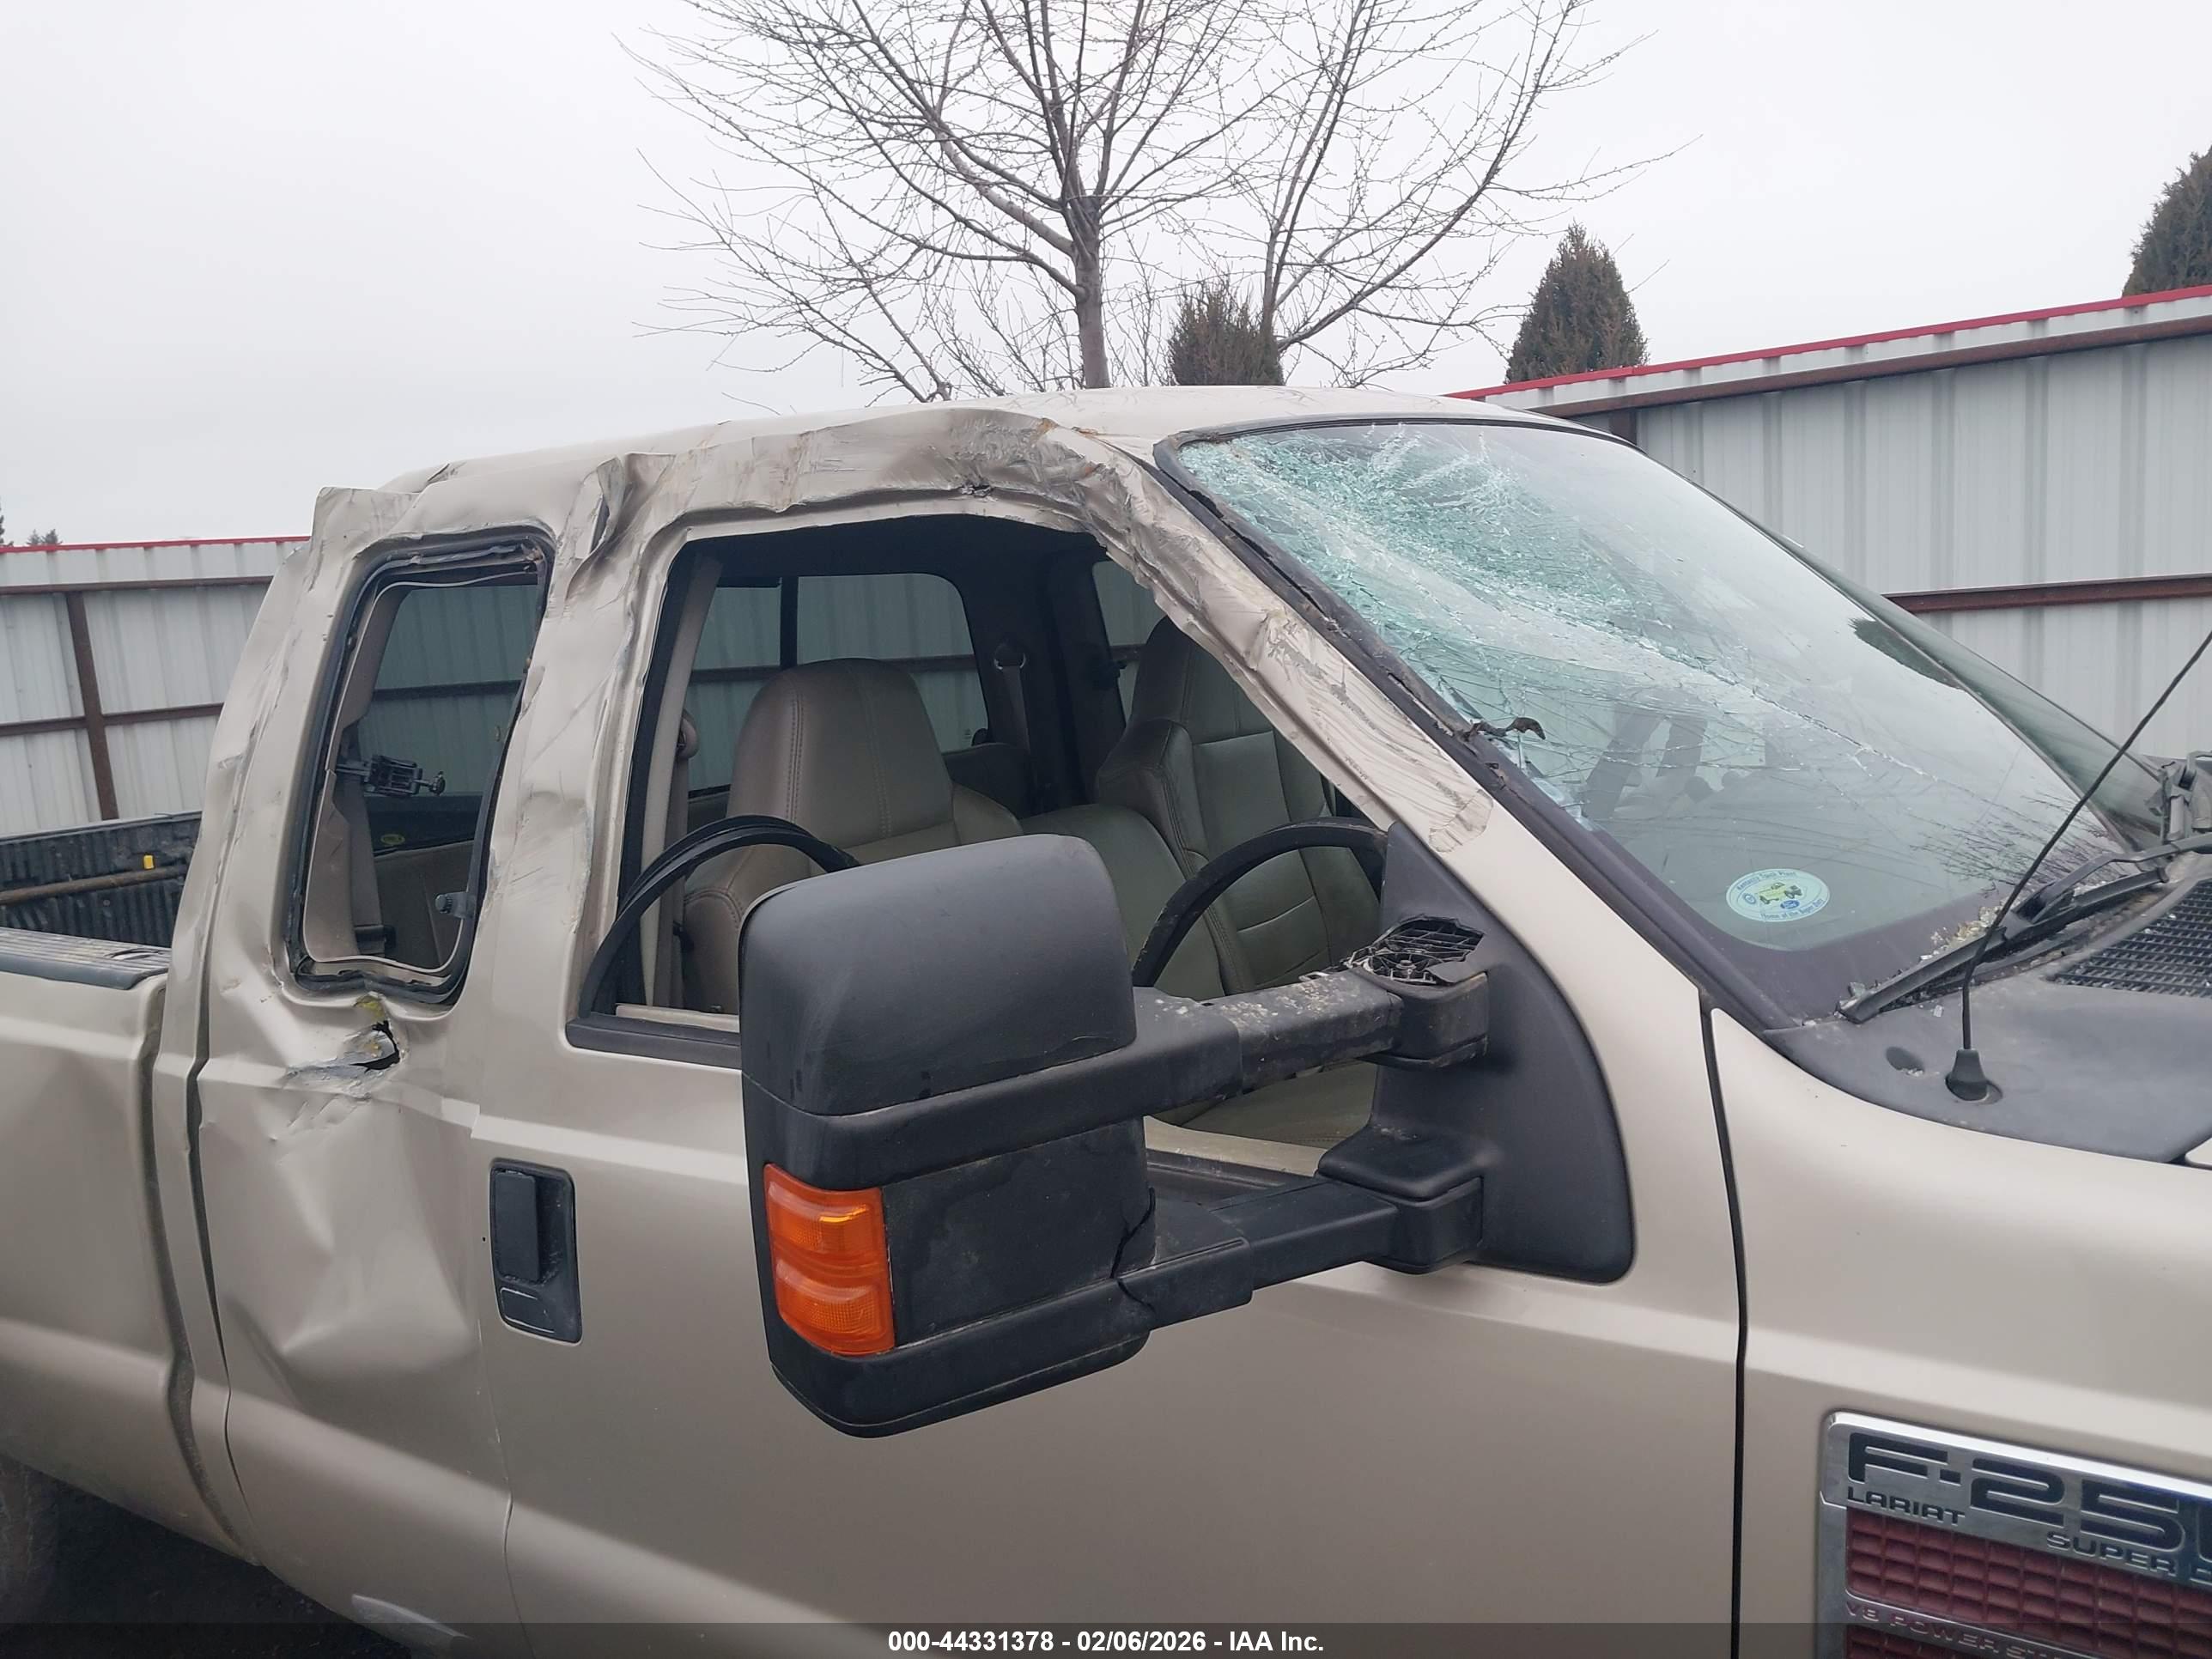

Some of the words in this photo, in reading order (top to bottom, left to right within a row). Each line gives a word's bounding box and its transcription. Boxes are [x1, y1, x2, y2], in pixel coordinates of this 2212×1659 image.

[1847, 1431, 2212, 1563] F-25
[1847, 1486, 1966, 1526] LARIAT
[2047, 1529, 2178, 1577] SUPER
[1846, 1601, 1879, 1622] V8
[1890, 1612, 2000, 1654] POWER
